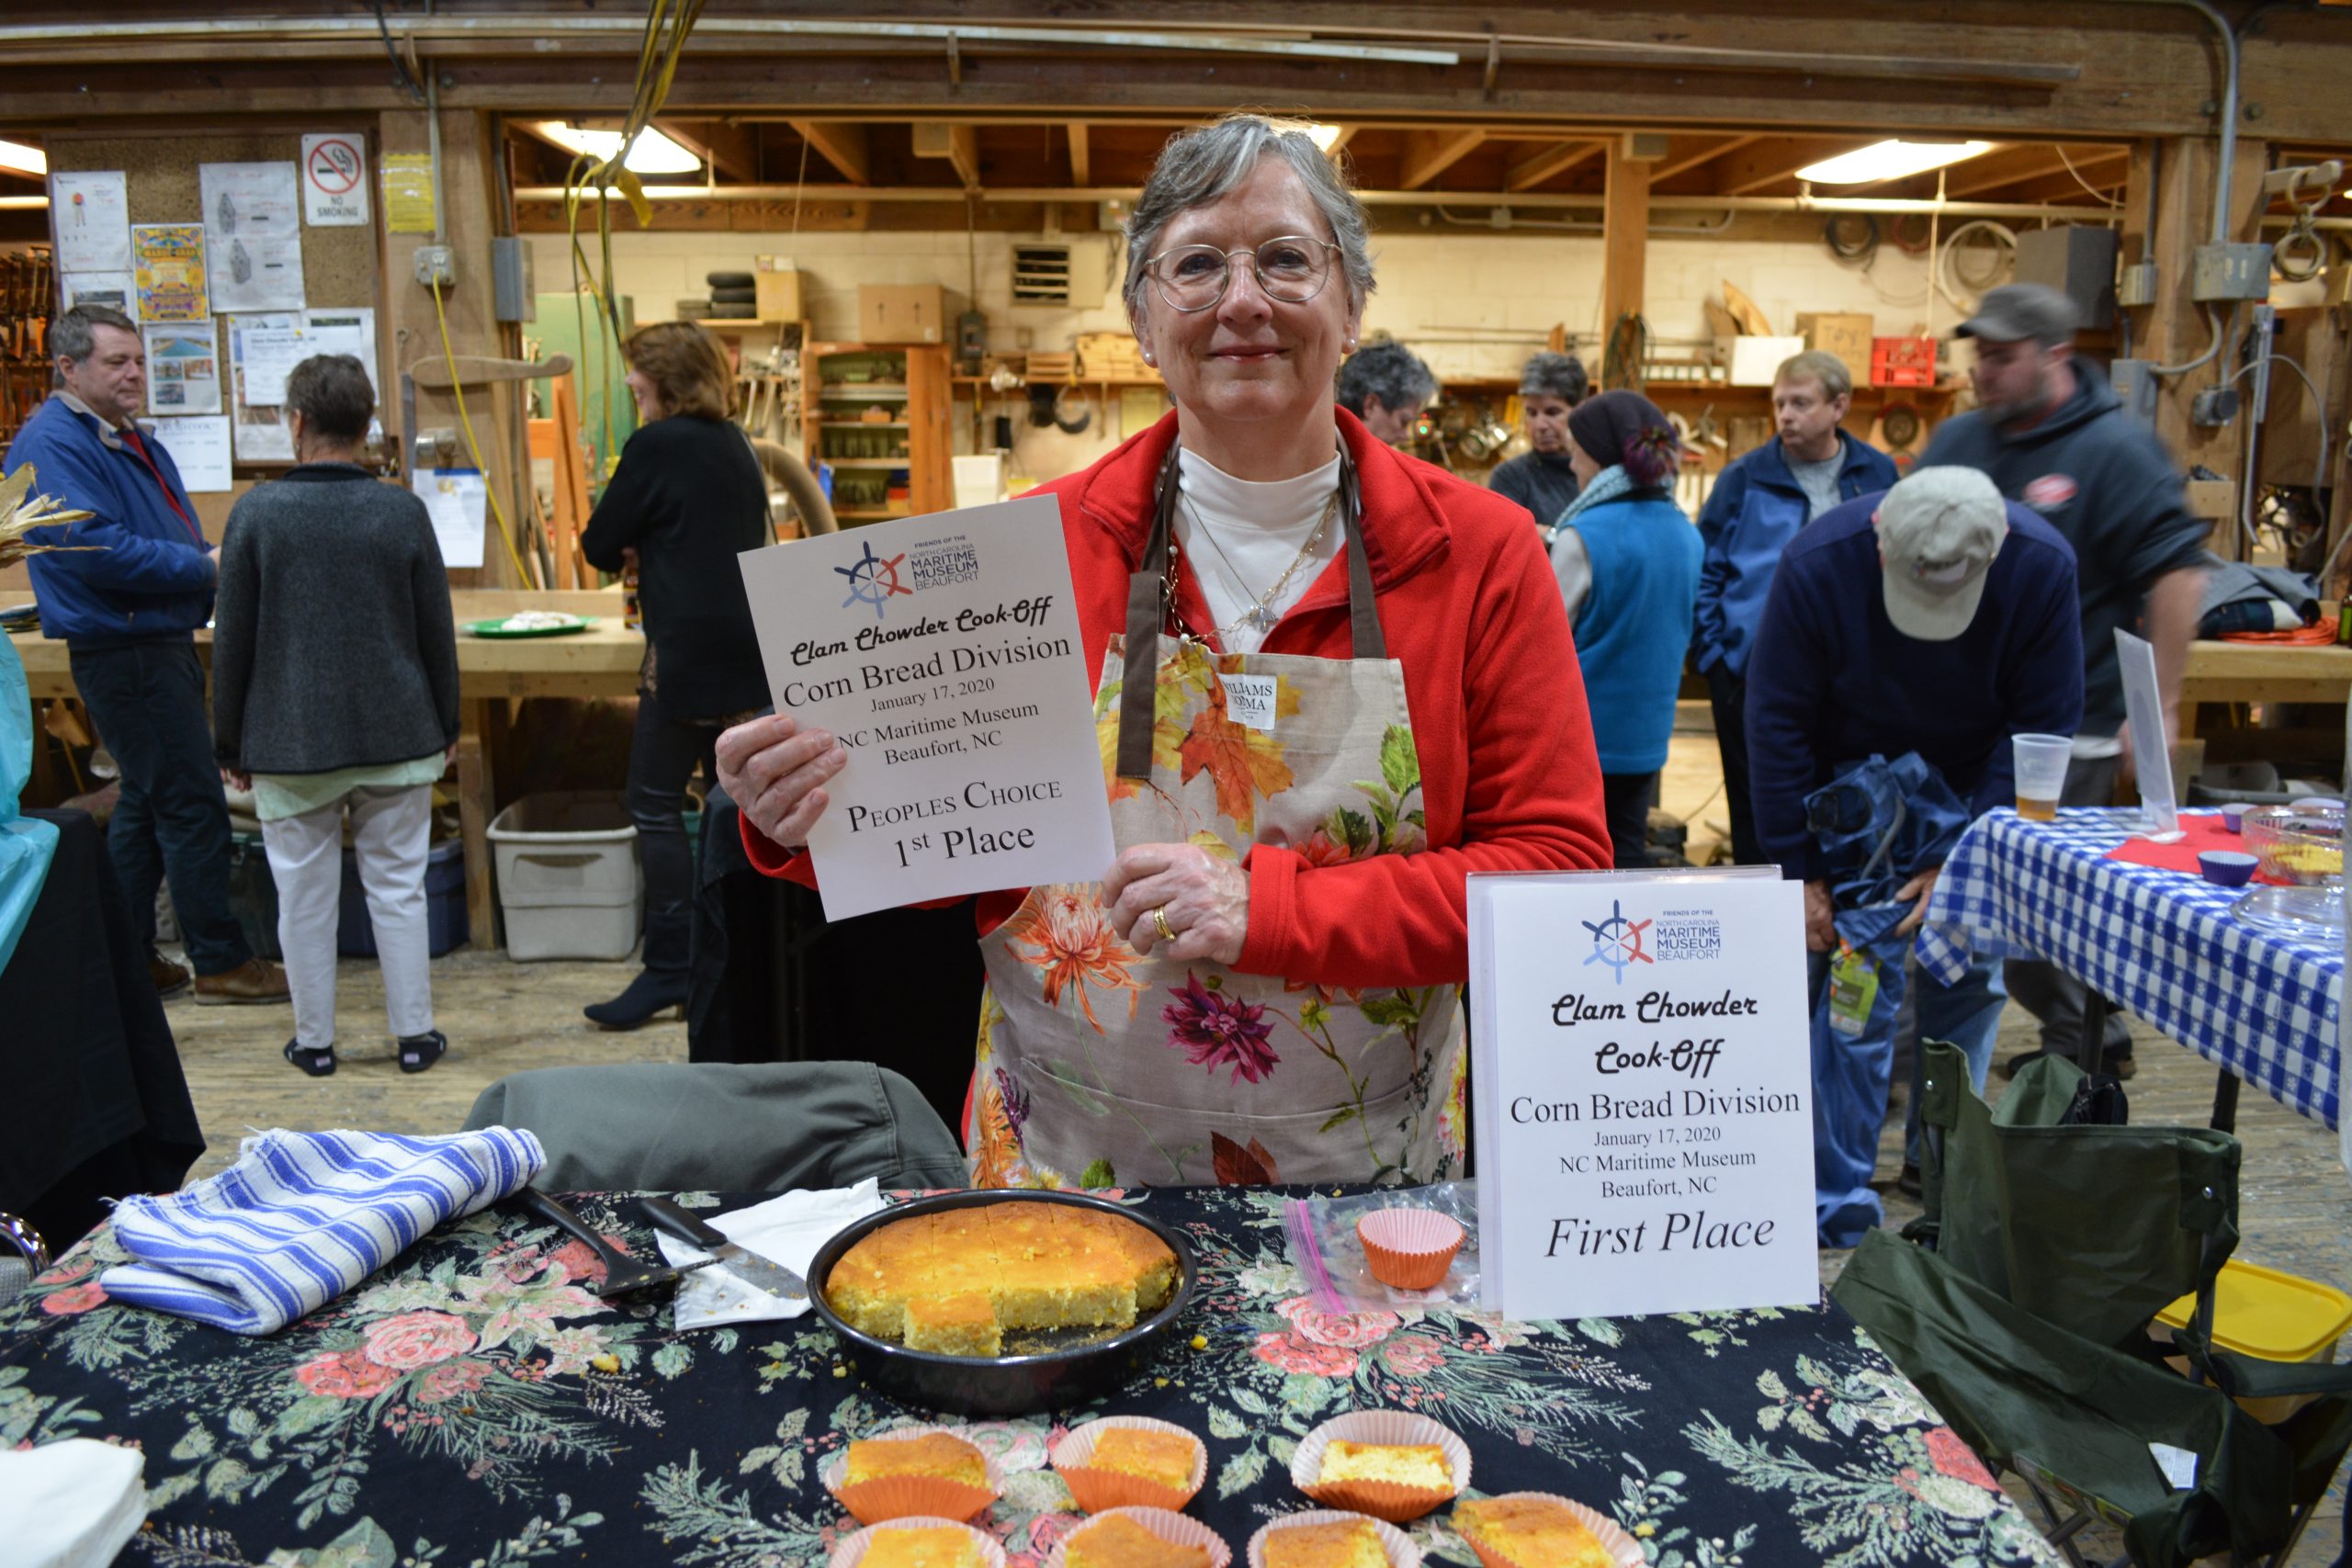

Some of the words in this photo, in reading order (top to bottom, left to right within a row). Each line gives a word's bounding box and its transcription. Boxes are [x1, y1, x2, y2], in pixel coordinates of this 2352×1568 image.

[330, 196, 345, 205] NO
[317, 207, 358, 217] SMOKING
[910, 548, 936, 559] NORTH
[936, 543, 975, 554] CAROLINA
[914, 539, 942, 548] FRIENDS
[910, 549, 977, 570] MARITIME
[913, 559, 978, 581] MUSEUM
[915, 570, 979, 591] BEAUFORT
[789, 639, 849, 667] Clam
[854, 616, 950, 652] Chowder
[955, 595, 1054, 633] Cook-Off
[784, 678, 854, 707] Corn
[860, 651, 944, 690] Bread
[951, 636, 1071, 672] Division
[871, 693, 926, 713] January
[933, 684, 956, 700] 17,
[958, 677, 995, 696] 2020
[837, 730, 867, 749] NC
[875, 717, 956, 743] Maritime
[962, 705, 1039, 727] Museum
[884, 739, 967, 765] Beaufort,
[971, 730, 1001, 750] NC
[846, 796, 957, 832] PEOPLES
[963, 781, 1062, 809] CHOICE
[896, 832, 931, 867] 1st
[942, 826, 1035, 859] Place
[1657, 927, 1721, 938] MARITIME
[1657, 939, 1721, 949] MUSEUM
[1657, 950, 1720, 962] BEAUFORT
[1551, 994, 1626, 1027] Clam
[1635, 988, 1758, 1023] Chowder
[1594, 1038, 1725, 1079] Cook-Off
[1510, 1097, 1579, 1123] Corn
[1591, 1090, 1672, 1121] Bread
[1683, 1087, 1800, 1116] Division
[1594, 1132, 1652, 1148] January
[1658, 1128, 1680, 1145] 17,
[1684, 1126, 1721, 1143] 2020
[1560, 1156, 1589, 1174] NC
[1596, 1152, 1676, 1172] Maritime
[1682, 1151, 1756, 1168] Museum
[1601, 1179, 1682, 1198] Beaufort,
[1688, 1176, 1716, 1194] NC
[1545, 1218, 1646, 1258] First
[1659, 1210, 1775, 1251] Place
